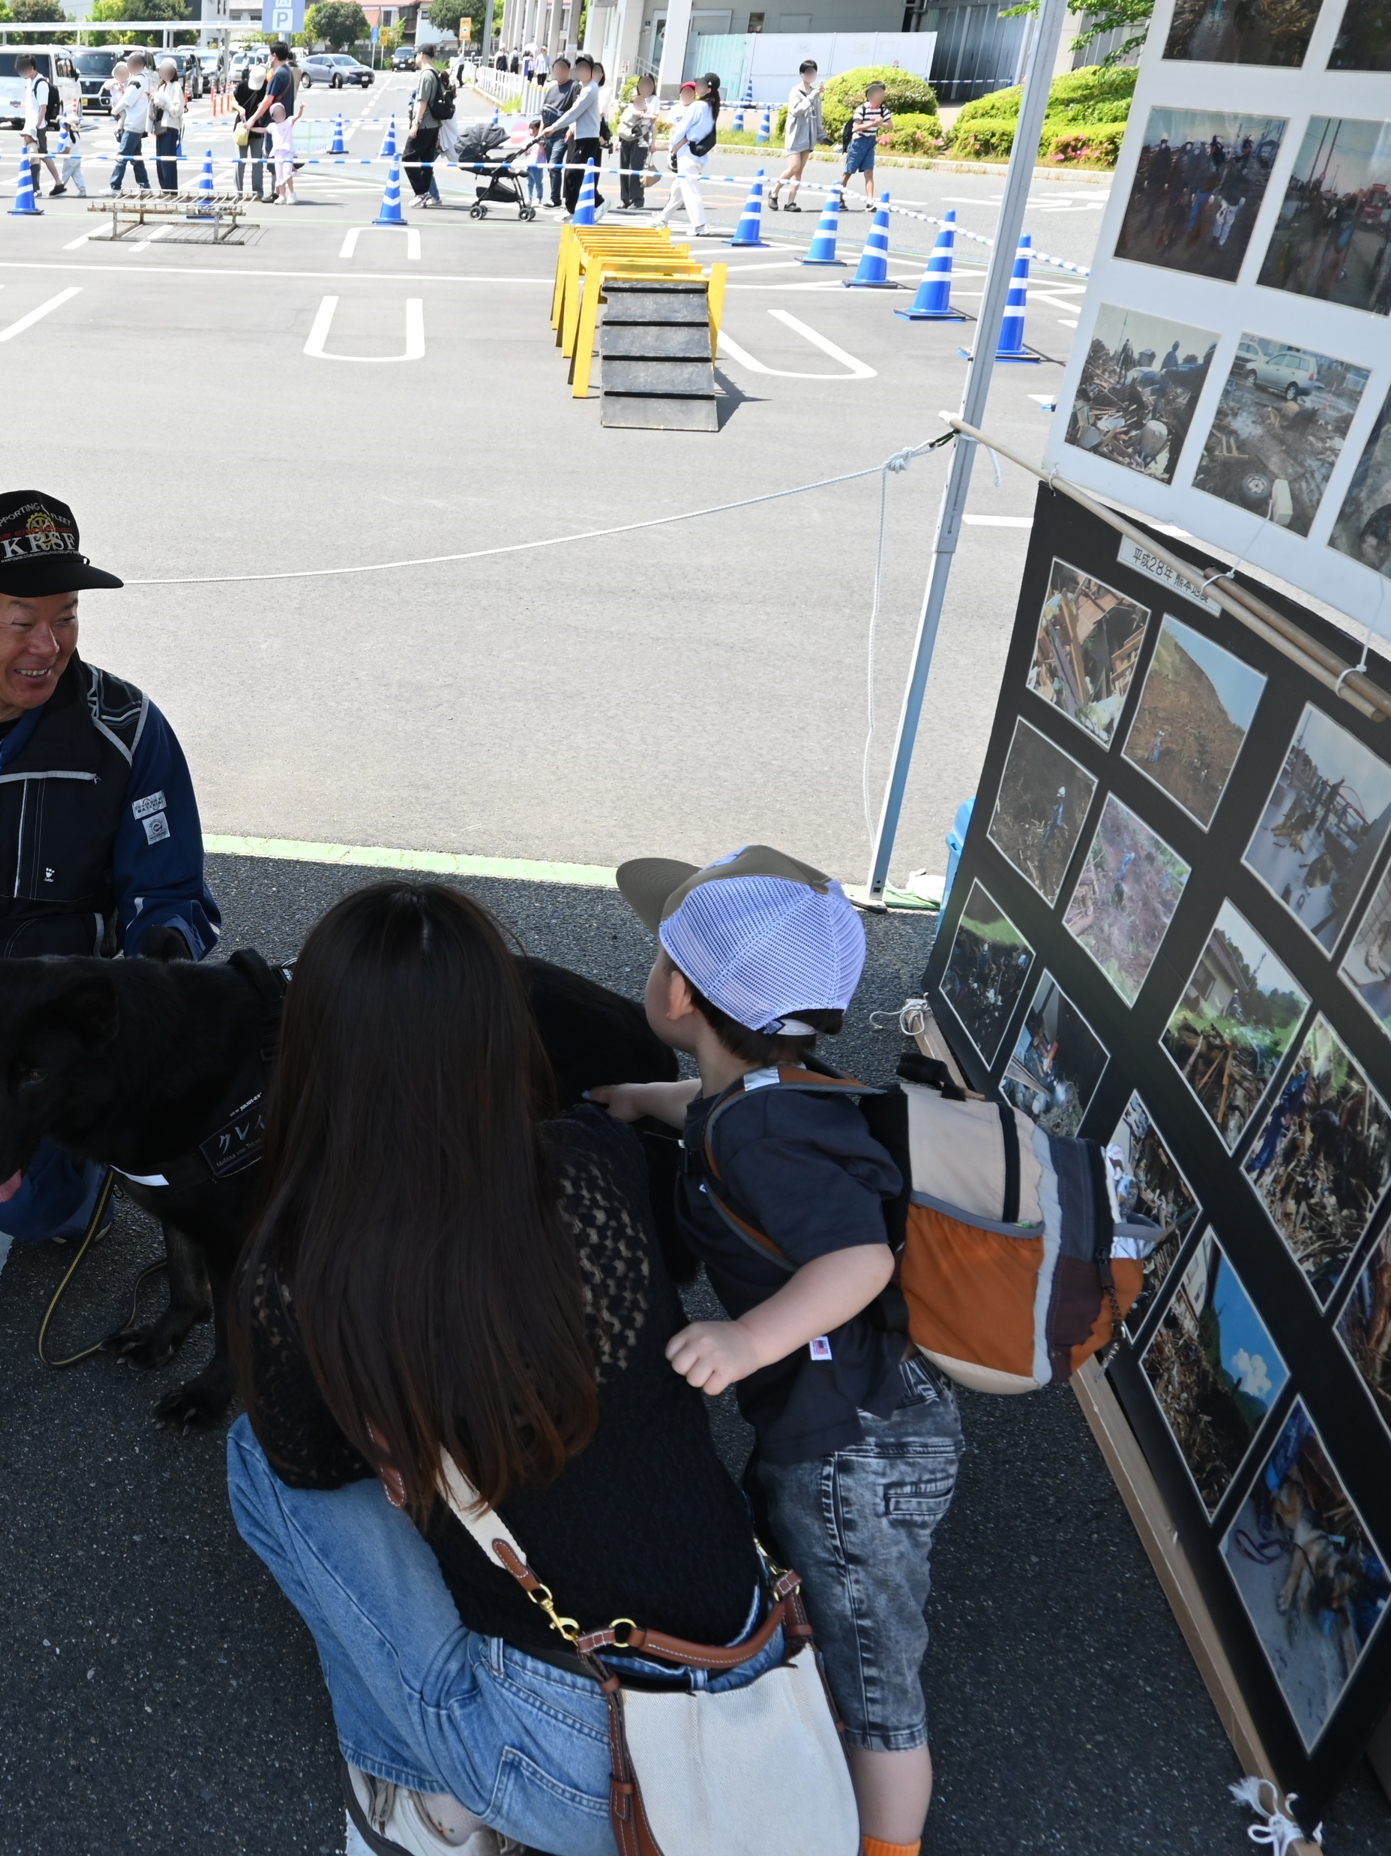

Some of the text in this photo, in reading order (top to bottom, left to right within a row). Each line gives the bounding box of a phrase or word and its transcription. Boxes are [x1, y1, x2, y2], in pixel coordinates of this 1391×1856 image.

[277, 12, 289, 28] P
[50, 512, 72, 526] FLEET
[0, 532, 76, 558] KRSF
[1132, 547, 1174, 581] 平成28年
